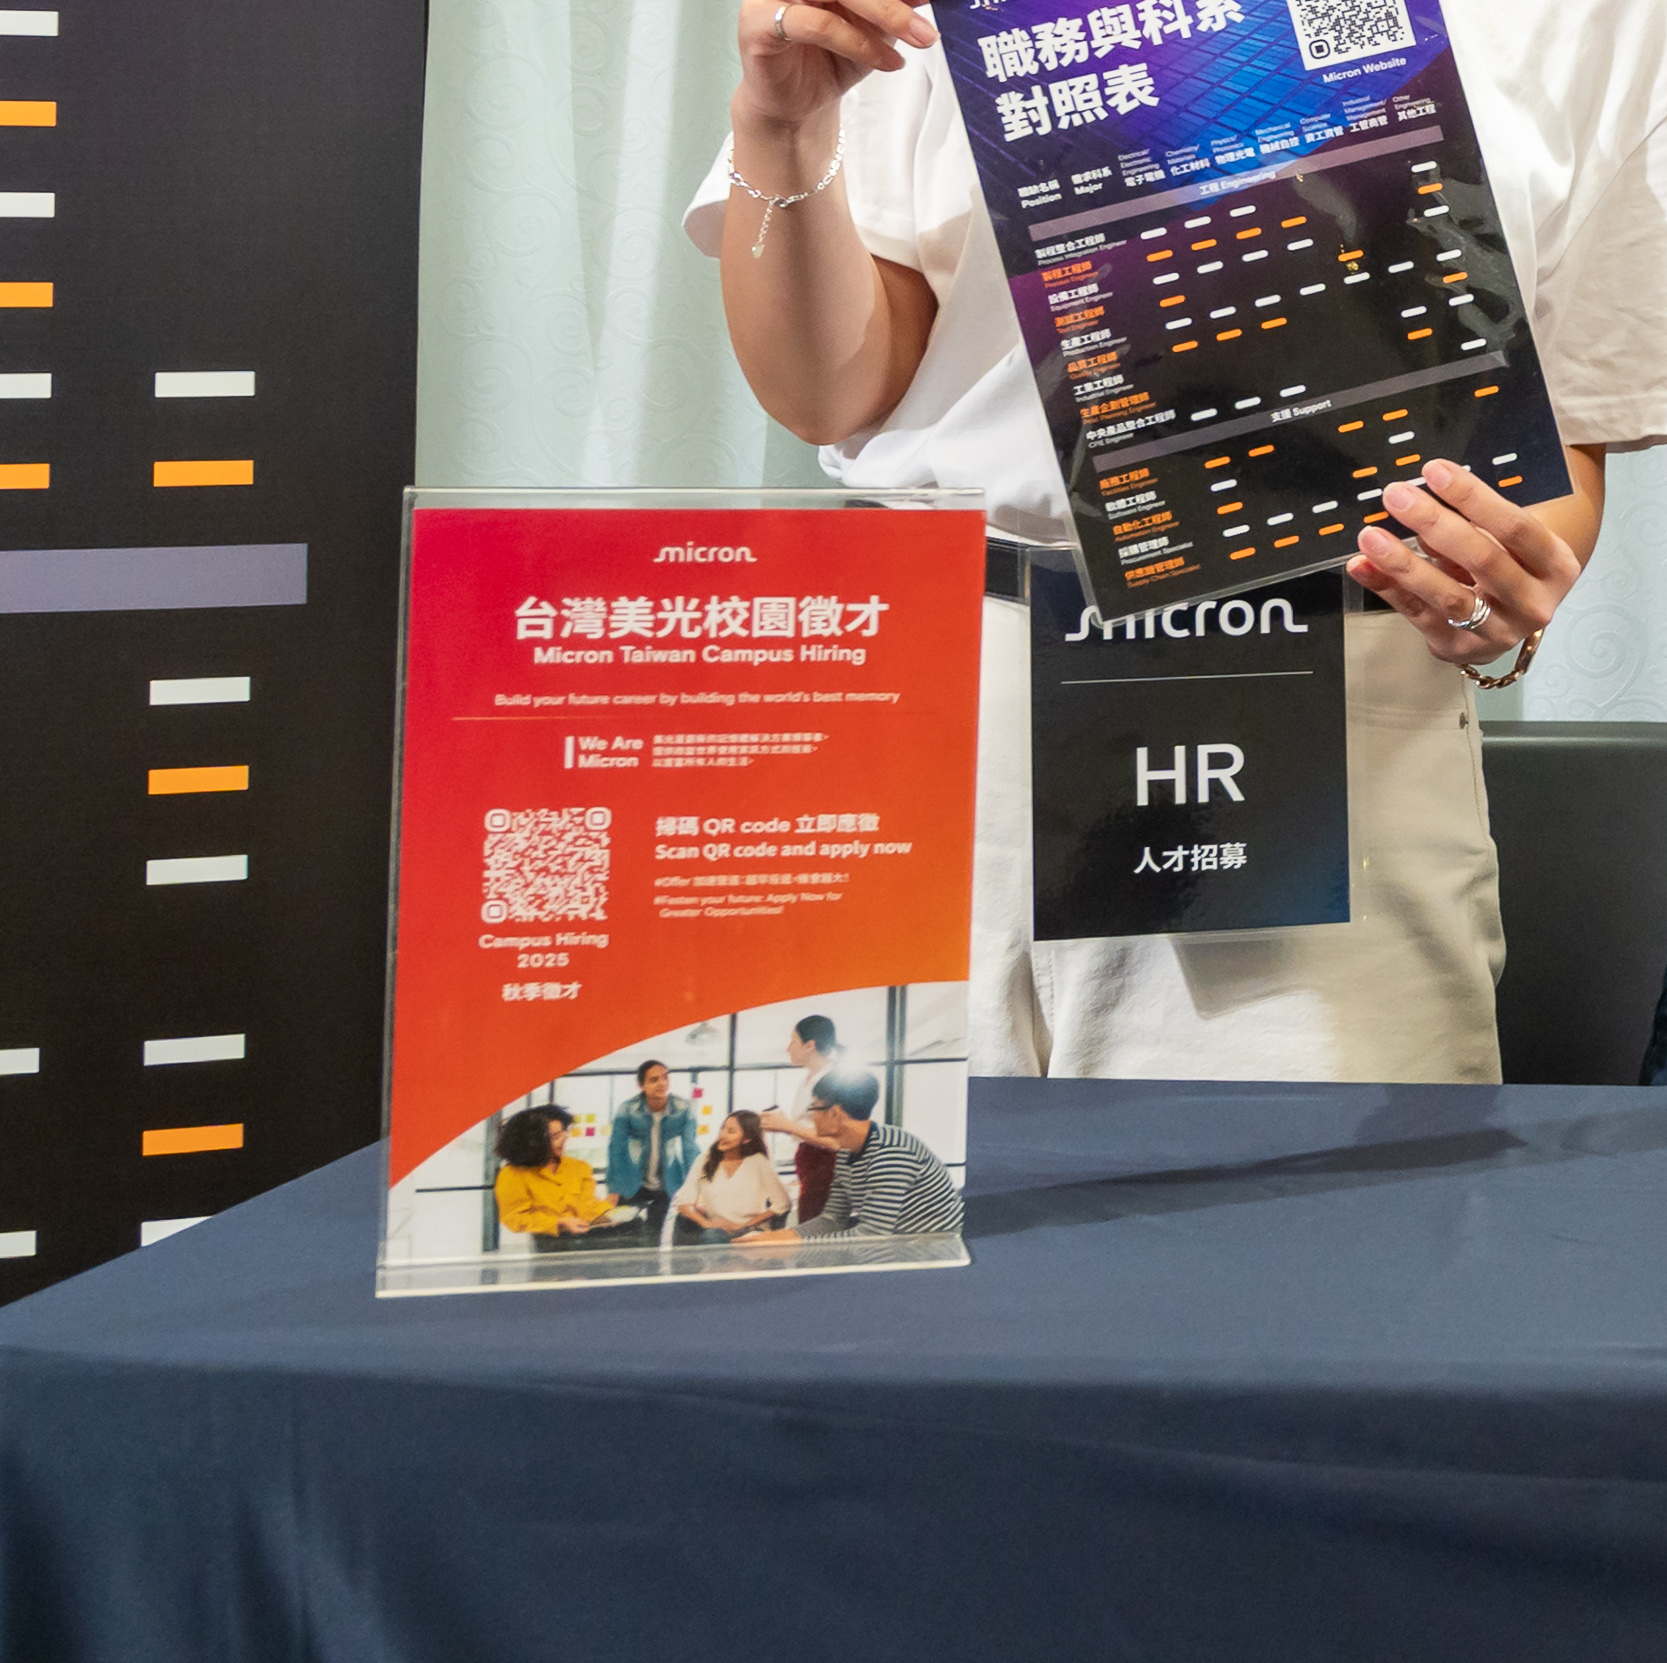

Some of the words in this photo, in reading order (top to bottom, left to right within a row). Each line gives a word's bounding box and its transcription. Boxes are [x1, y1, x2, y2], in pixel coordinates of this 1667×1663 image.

[1321, 67, 1362, 84] Micron
[1362, 56, 1407, 75] Website
[993, 61, 1161, 143] 對照表
[1074, 182, 1104, 196] Major
[1220, 169, 1277, 189] Engineering
[1021, 192, 1063, 209] Position
[1292, 398, 1333, 417] Support
[653, 541, 758, 564] micron
[513, 595, 890, 641] 台灣美光校園徵才
[533, 644, 615, 666] Micron
[619, 644, 697, 665] Taiwan
[701, 643, 795, 667] Campus
[799, 642, 867, 666] Hiring
[494, 692, 531, 707] Build
[532, 694, 566, 709] your
[567, 692, 604, 706] future
[605, 693, 658, 706] career
[659, 691, 679, 708] by
[679, 691, 736, 708] building
[737, 691, 762, 705] the
[811, 690, 842, 705] best
[842, 692, 901, 707] memory
[578, 735, 608, 751] We
[611, 735, 644, 751] Are
[578, 752, 639, 769] Micron
[1135, 741, 1247, 808] HR
[703, 817, 736, 837] QR
[740, 816, 792, 835] code
[654, 843, 700, 861] Scan
[702, 842, 732, 862] QR
[733, 841, 778, 858] code
[780, 840, 817, 858] and
[818, 839, 870, 860] apply
[872, 841, 914, 855] now
[1133, 841, 1249, 875] 人才招募
[477, 932, 553, 953] Campus
[555, 929, 610, 951] Hiring
[516, 951, 570, 969] 2025
